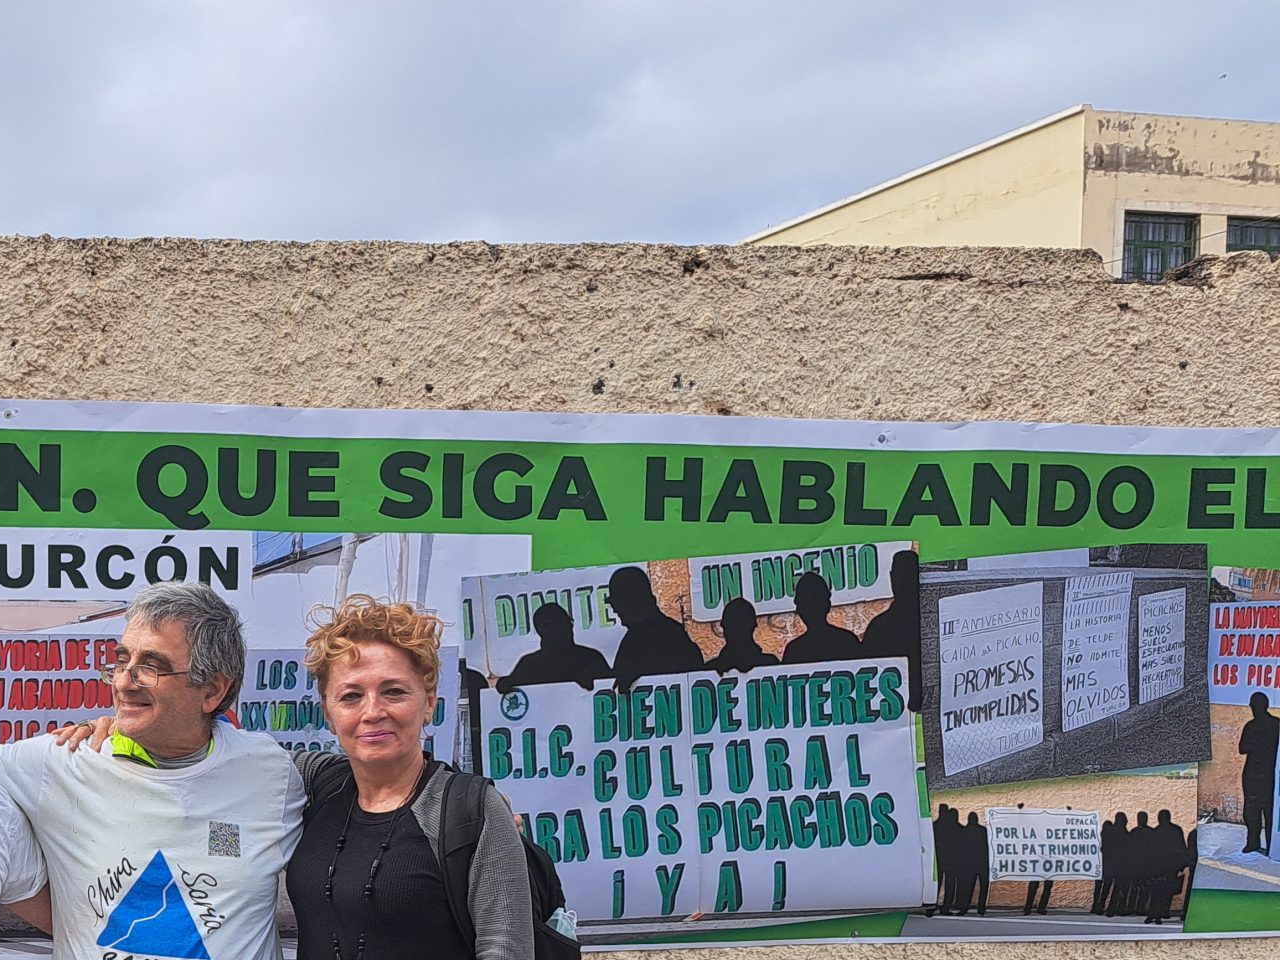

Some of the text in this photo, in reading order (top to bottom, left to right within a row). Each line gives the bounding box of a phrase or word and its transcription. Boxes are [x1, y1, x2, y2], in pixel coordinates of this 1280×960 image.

[136, 444, 340, 530] QUE
[378, 451, 608, 521] SIGA
[644, 456, 1154, 530] HABLANDO
[1187, 467, 1280, 529] EL
[702, 564, 741, 609] UN
[960, 606, 1041, 633] ANIVERSARIO
[1085, 613, 1122, 627] HISTORIA
[1143, 601, 1185, 619] PICACHOS
[1214, 606, 1230, 629] LA
[1086, 633, 1114, 645] TELDE
[1140, 635, 1167, 649] SUELO
[1142, 622, 1172, 638] MENOS
[65, 638, 90, 670] DE
[941, 644, 977, 664] CAIDA
[1219, 633, 1236, 657] DE
[1236, 633, 1256, 657] UN
[1066, 653, 1083, 666] NO
[256, 659, 298, 690] LOS
[953, 656, 1035, 698] PROMESAS
[1065, 670, 1098, 692] MAS
[1214, 664, 1238, 685] LOS
[8, 677, 115, 711] ABANDON
[593, 666, 905, 743] BIEN DE INTERES
[1066, 684, 1127, 718] OLVIDOS
[488, 725, 586, 780] B.I.C.
[593, 733, 871, 802] CULTURAL
[598, 803, 683, 859] LOS
[696, 791, 899, 855] PICACHOS
[995, 827, 1097, 840] POR LA DEFENSA
[996, 843, 1098, 856] DEL PATRIMONIO
[999, 859, 1093, 873] HISTORICO
[87, 857, 138, 928] Chira
[176, 862, 226, 935] Soria
